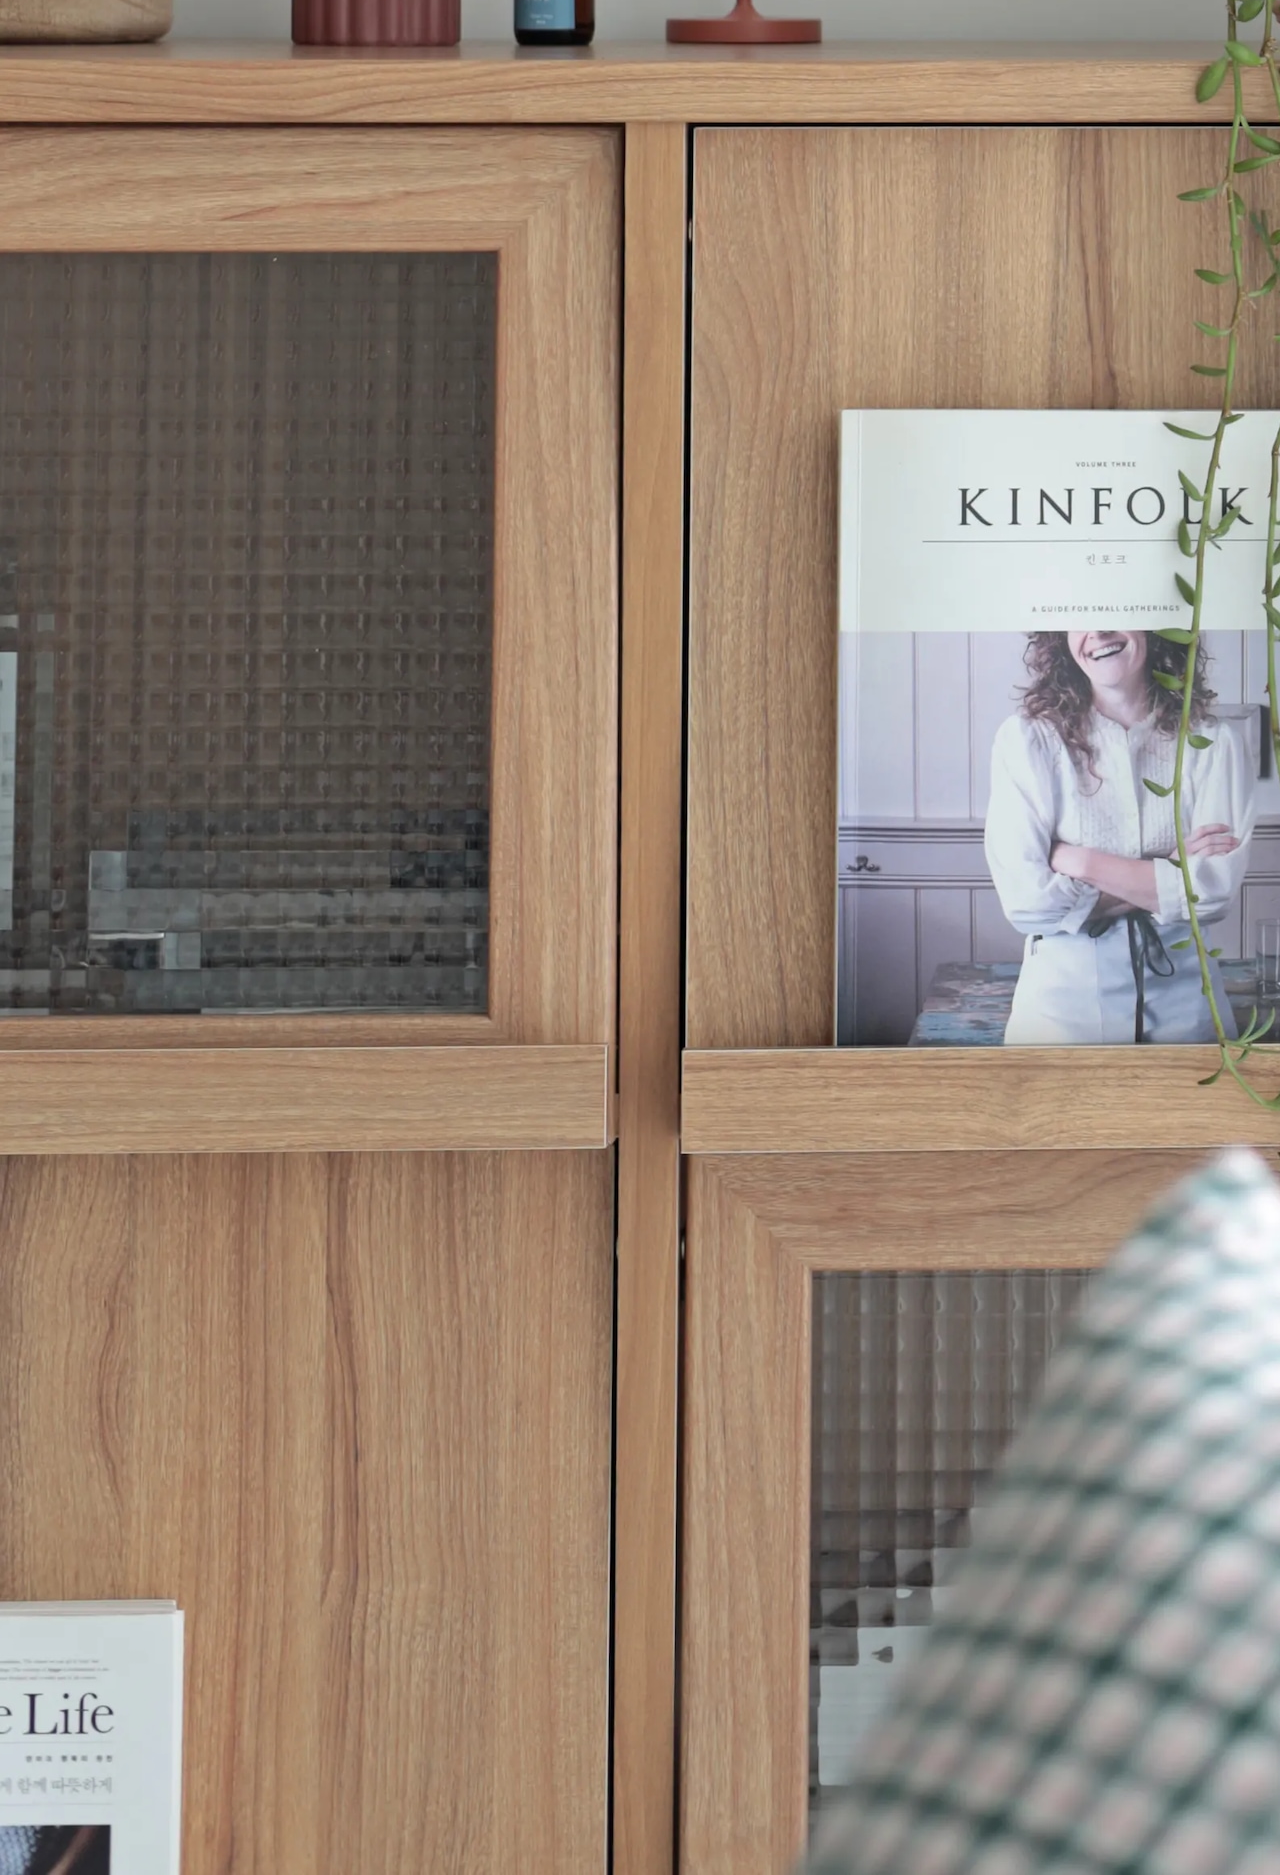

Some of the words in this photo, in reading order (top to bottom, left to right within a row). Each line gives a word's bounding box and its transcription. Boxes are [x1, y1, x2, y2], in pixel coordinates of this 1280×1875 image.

[957, 486, 1255, 527] KINFOLK
[1085, 553, 1127, 566] 킨포크
[1031, 605, 1037, 613] A
[1041, 605, 1069, 613] GUIDE
[1072, 605, 1089, 613] FOR
[1092, 605, 1121, 613] SMALL
[1123, 604, 1181, 613] GATHERINGS
[22, 1691, 115, 1735] Life
